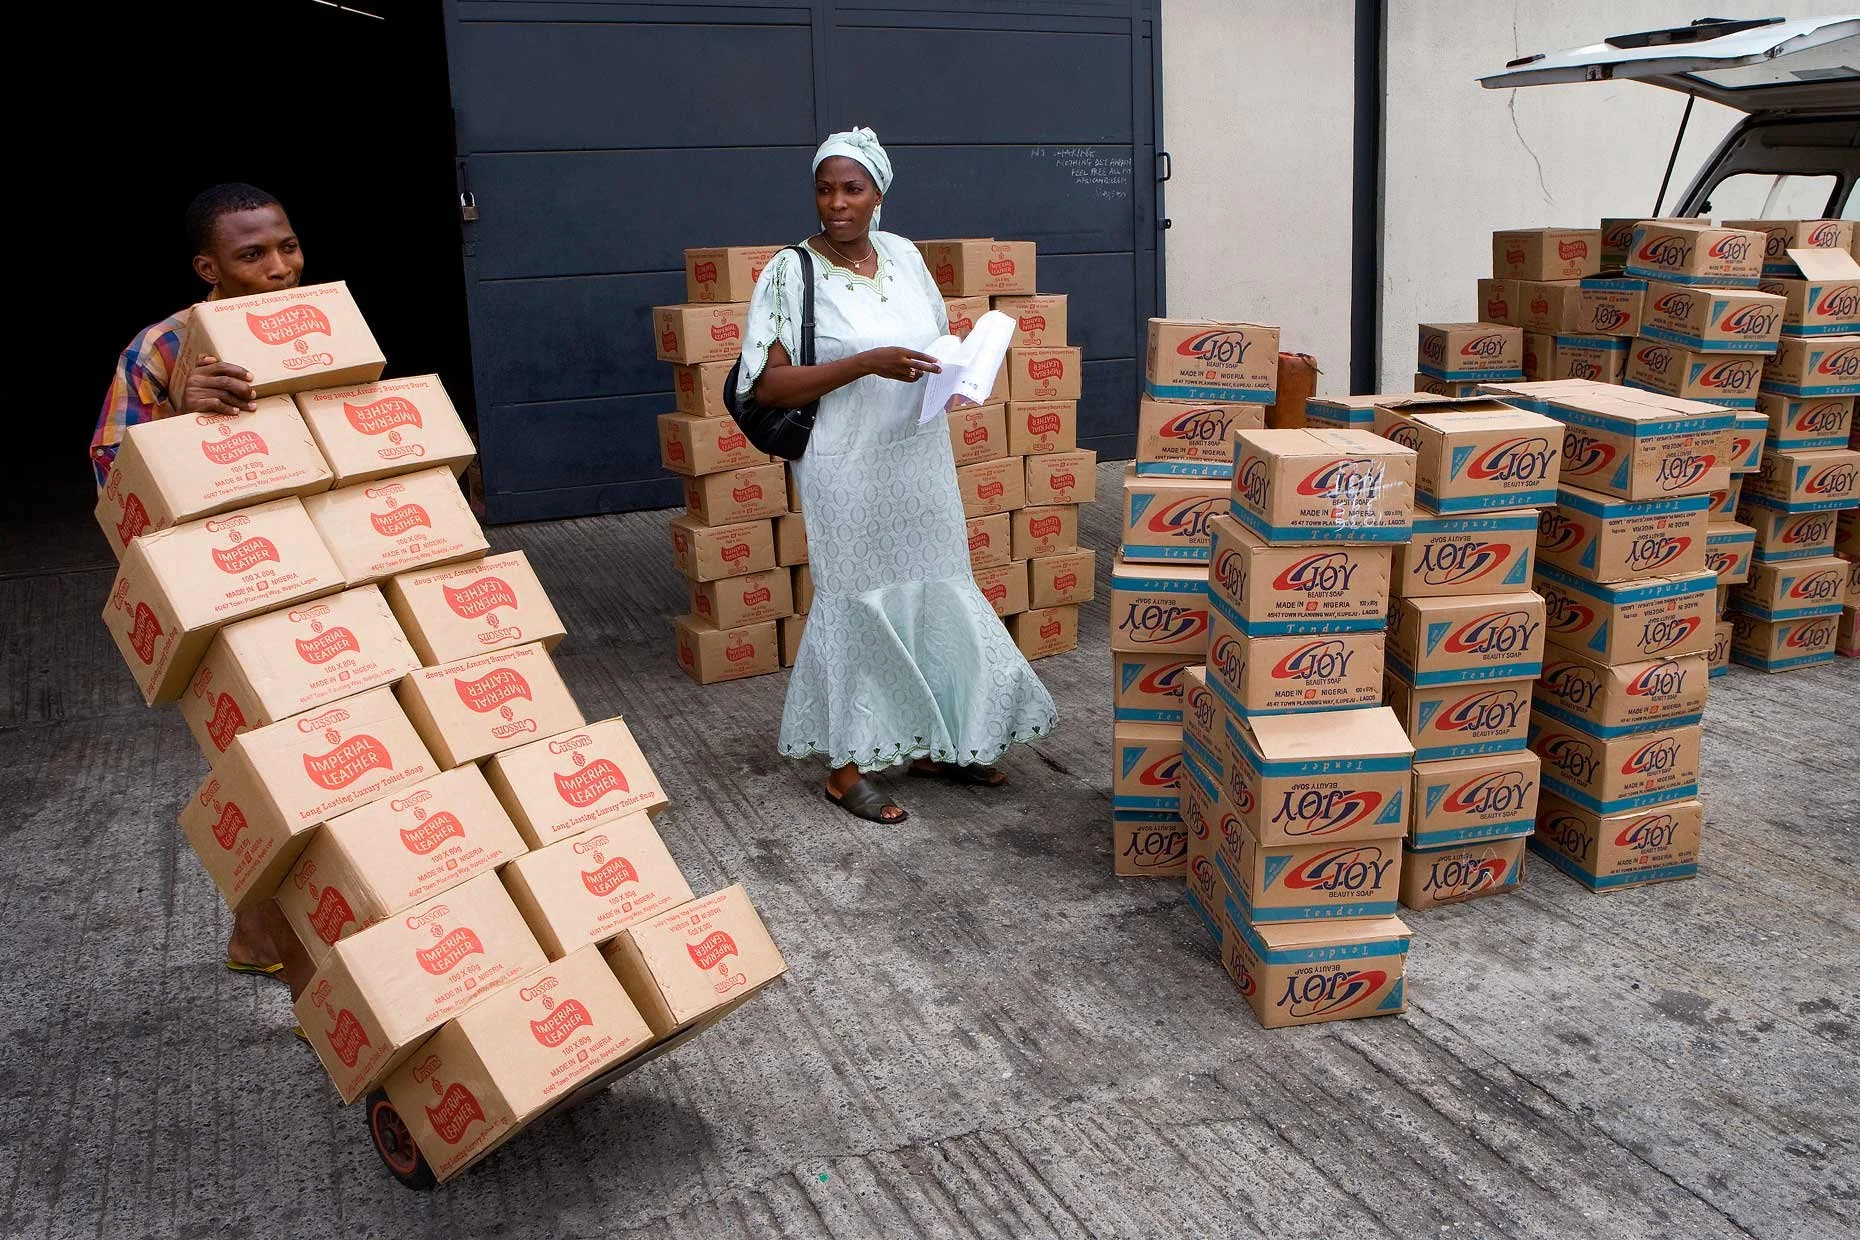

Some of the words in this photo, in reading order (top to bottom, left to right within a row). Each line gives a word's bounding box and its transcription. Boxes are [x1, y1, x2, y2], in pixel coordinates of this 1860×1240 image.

[1821, 230, 1841, 248] JOY
[1656, 246, 1692, 267] JOY
[1724, 242, 1752, 261] JOY
[259, 308, 317, 329] LEATHER
[1667, 299, 1694, 319] JOY
[263, 319, 326, 342] IMPERIAL
[1741, 314, 1780, 334] JOY
[1202, 338, 1252, 364] JOY
[1479, 340, 1507, 355] JOY
[282, 352, 333, 370] Cussons
[1033, 360, 1060, 370] LEATHER
[1030, 367, 1062, 379] IMPERIAL
[1720, 369, 1759, 388] JOY
[1188, 389, 1246, 400] Tender
[355, 400, 408, 420] LEATHER
[1815, 410, 1848, 432] JOY
[359, 411, 417, 432] IMPERIAL
[1185, 418, 1233, 442] JOY
[1658, 420, 1706, 429] Tender
[207, 433, 255, 453] IMPERIAL
[214, 442, 260, 464] LEATHER
[377, 443, 425, 460] Cussons
[1170, 464, 1228, 476] Tender
[1499, 449, 1557, 480] JOY
[1655, 455, 1697, 482] JOY
[364, 483, 406, 499] Cussons
[1243, 473, 1270, 510] JOY
[1826, 471, 1859, 493] JOY
[1483, 496, 1532, 507] Tender
[205, 515, 251, 533] Cussons
[375, 506, 419, 525] IMPERIAL
[382, 515, 424, 534] LEATHER
[1311, 530, 1379, 540] Tender
[217, 540, 268, 562] IMPERIAL
[225, 550, 271, 571] LEATHER
[1163, 548, 1207, 558] Tende
[1413, 542, 1476, 574] JOY
[1625, 538, 1668, 563] JOY
[225, 587, 245, 599] MADE
[271, 572, 299, 585] NIGERIA
[1143, 581, 1198, 592] Tender
[1301, 564, 1358, 592] JOY
[1809, 579, 1842, 599] JOY
[453, 580, 504, 602] LEATHER
[287, 604, 331, 623] Cussons
[458, 592, 513, 615] IMPERIAL
[1275, 601, 1296, 609] MADE
[1119, 603, 1180, 632] JOY
[1287, 624, 1352, 633] Tender
[299, 630, 348, 652] IMPERIAL
[477, 626, 522, 645] Cussons
[1479, 622, 1539, 653] JOY
[1637, 619, 1680, 648] JOY
[1804, 626, 1836, 647] JOY
[308, 640, 351, 662] LEATHER
[515, 649, 534, 658] Long
[425, 670, 444, 679] Soap
[466, 659, 489, 670] Luxury
[1300, 650, 1354, 680] JOY
[1461, 667, 1513, 679] Tender
[468, 671, 515, 697] LEATHER
[1321, 688, 1348, 696] NIGERIA
[1558, 672, 1602, 709] JOY
[1649, 670, 1687, 696] JOY
[473, 684, 526, 709] IMPERIAL
[297, 708, 351, 734] Cussons
[1468, 700, 1527, 730] JOY
[491, 718, 537, 739] Cussons
[310, 738, 374, 771] IMPERIAL
[548, 734, 593, 754] Cussons
[320, 752, 380, 786] LEATHER
[1301, 761, 1364, 772] Tender
[1645, 744, 1681, 772] JOY
[560, 762, 613, 790] IMPERIAL
[299, 806, 322, 820] Long
[322, 794, 354, 811] Lasting
[353, 781, 381, 798] Luxury
[380, 773, 405, 788] Toilet
[405, 765, 425, 779] Soap
[569, 775, 619, 804] LEATHER
[1476, 781, 1533, 813] JOY
[390, 790, 433, 812] Cussons
[551, 821, 571, 833] Long
[570, 810, 597, 826] Lasting
[595, 801, 620, 817] Luxury
[620, 795, 640, 807] Toilet
[639, 791, 655, 801] Soap
[1271, 790, 1344, 823] JOY
[404, 815, 450, 842] IMPERIAL
[414, 825, 456, 851] LEATHER
[1637, 822, 1679, 849] JOY
[572, 835, 610, 854] Cussons
[1123, 832, 1186, 856] JOY
[586, 859, 626, 884] IMPERIAL
[594, 870, 631, 892] LEATHER
[1321, 858, 1394, 890] JOY
[1423, 859, 1478, 892] JOY
[406, 904, 451, 930] Cussons
[1304, 906, 1364, 918] Tender
[422, 931, 471, 962] IMPERIAL
[431, 941, 473, 971] LEATHER
[694, 934, 728, 957] LEATHER
[698, 942, 734, 968] IMPERIAL
[1307, 946, 1368, 958] Tender
[519, 976, 559, 1001] Cussons
[1277, 971, 1349, 1006] JOY
[536, 1002, 579, 1034] IMPERIAL
[545, 1013, 584, 1045] LEATHER
[549, 1064, 567, 1078] MADE
[568, 1060, 575, 1068] IN
[589, 1035, 613, 1054] NIGERIA
[562, 1045, 574, 1056] 100
[431, 1087, 467, 1125] IMPERIAL
[442, 1103, 476, 1140] LEATHER
